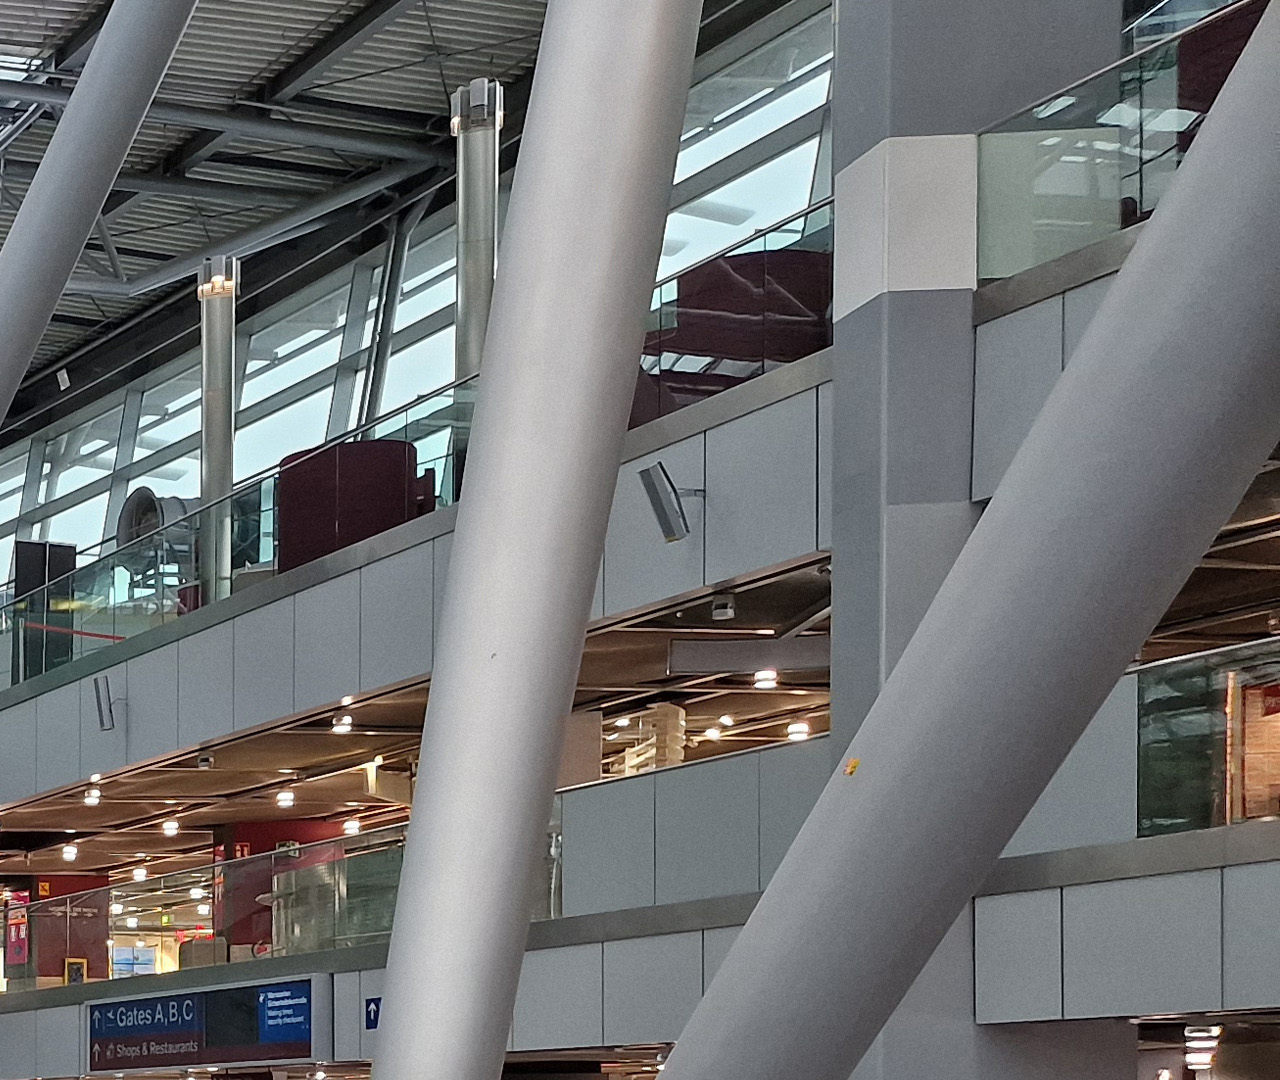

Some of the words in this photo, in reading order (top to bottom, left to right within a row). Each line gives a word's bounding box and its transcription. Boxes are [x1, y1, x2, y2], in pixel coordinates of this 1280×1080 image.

[116, 1006, 152, 1028] Gates
[116, 1044, 141, 1058] Shops
[142, 1042, 148, 1056] &
[149, 1040, 199, 1055] Restaurants
